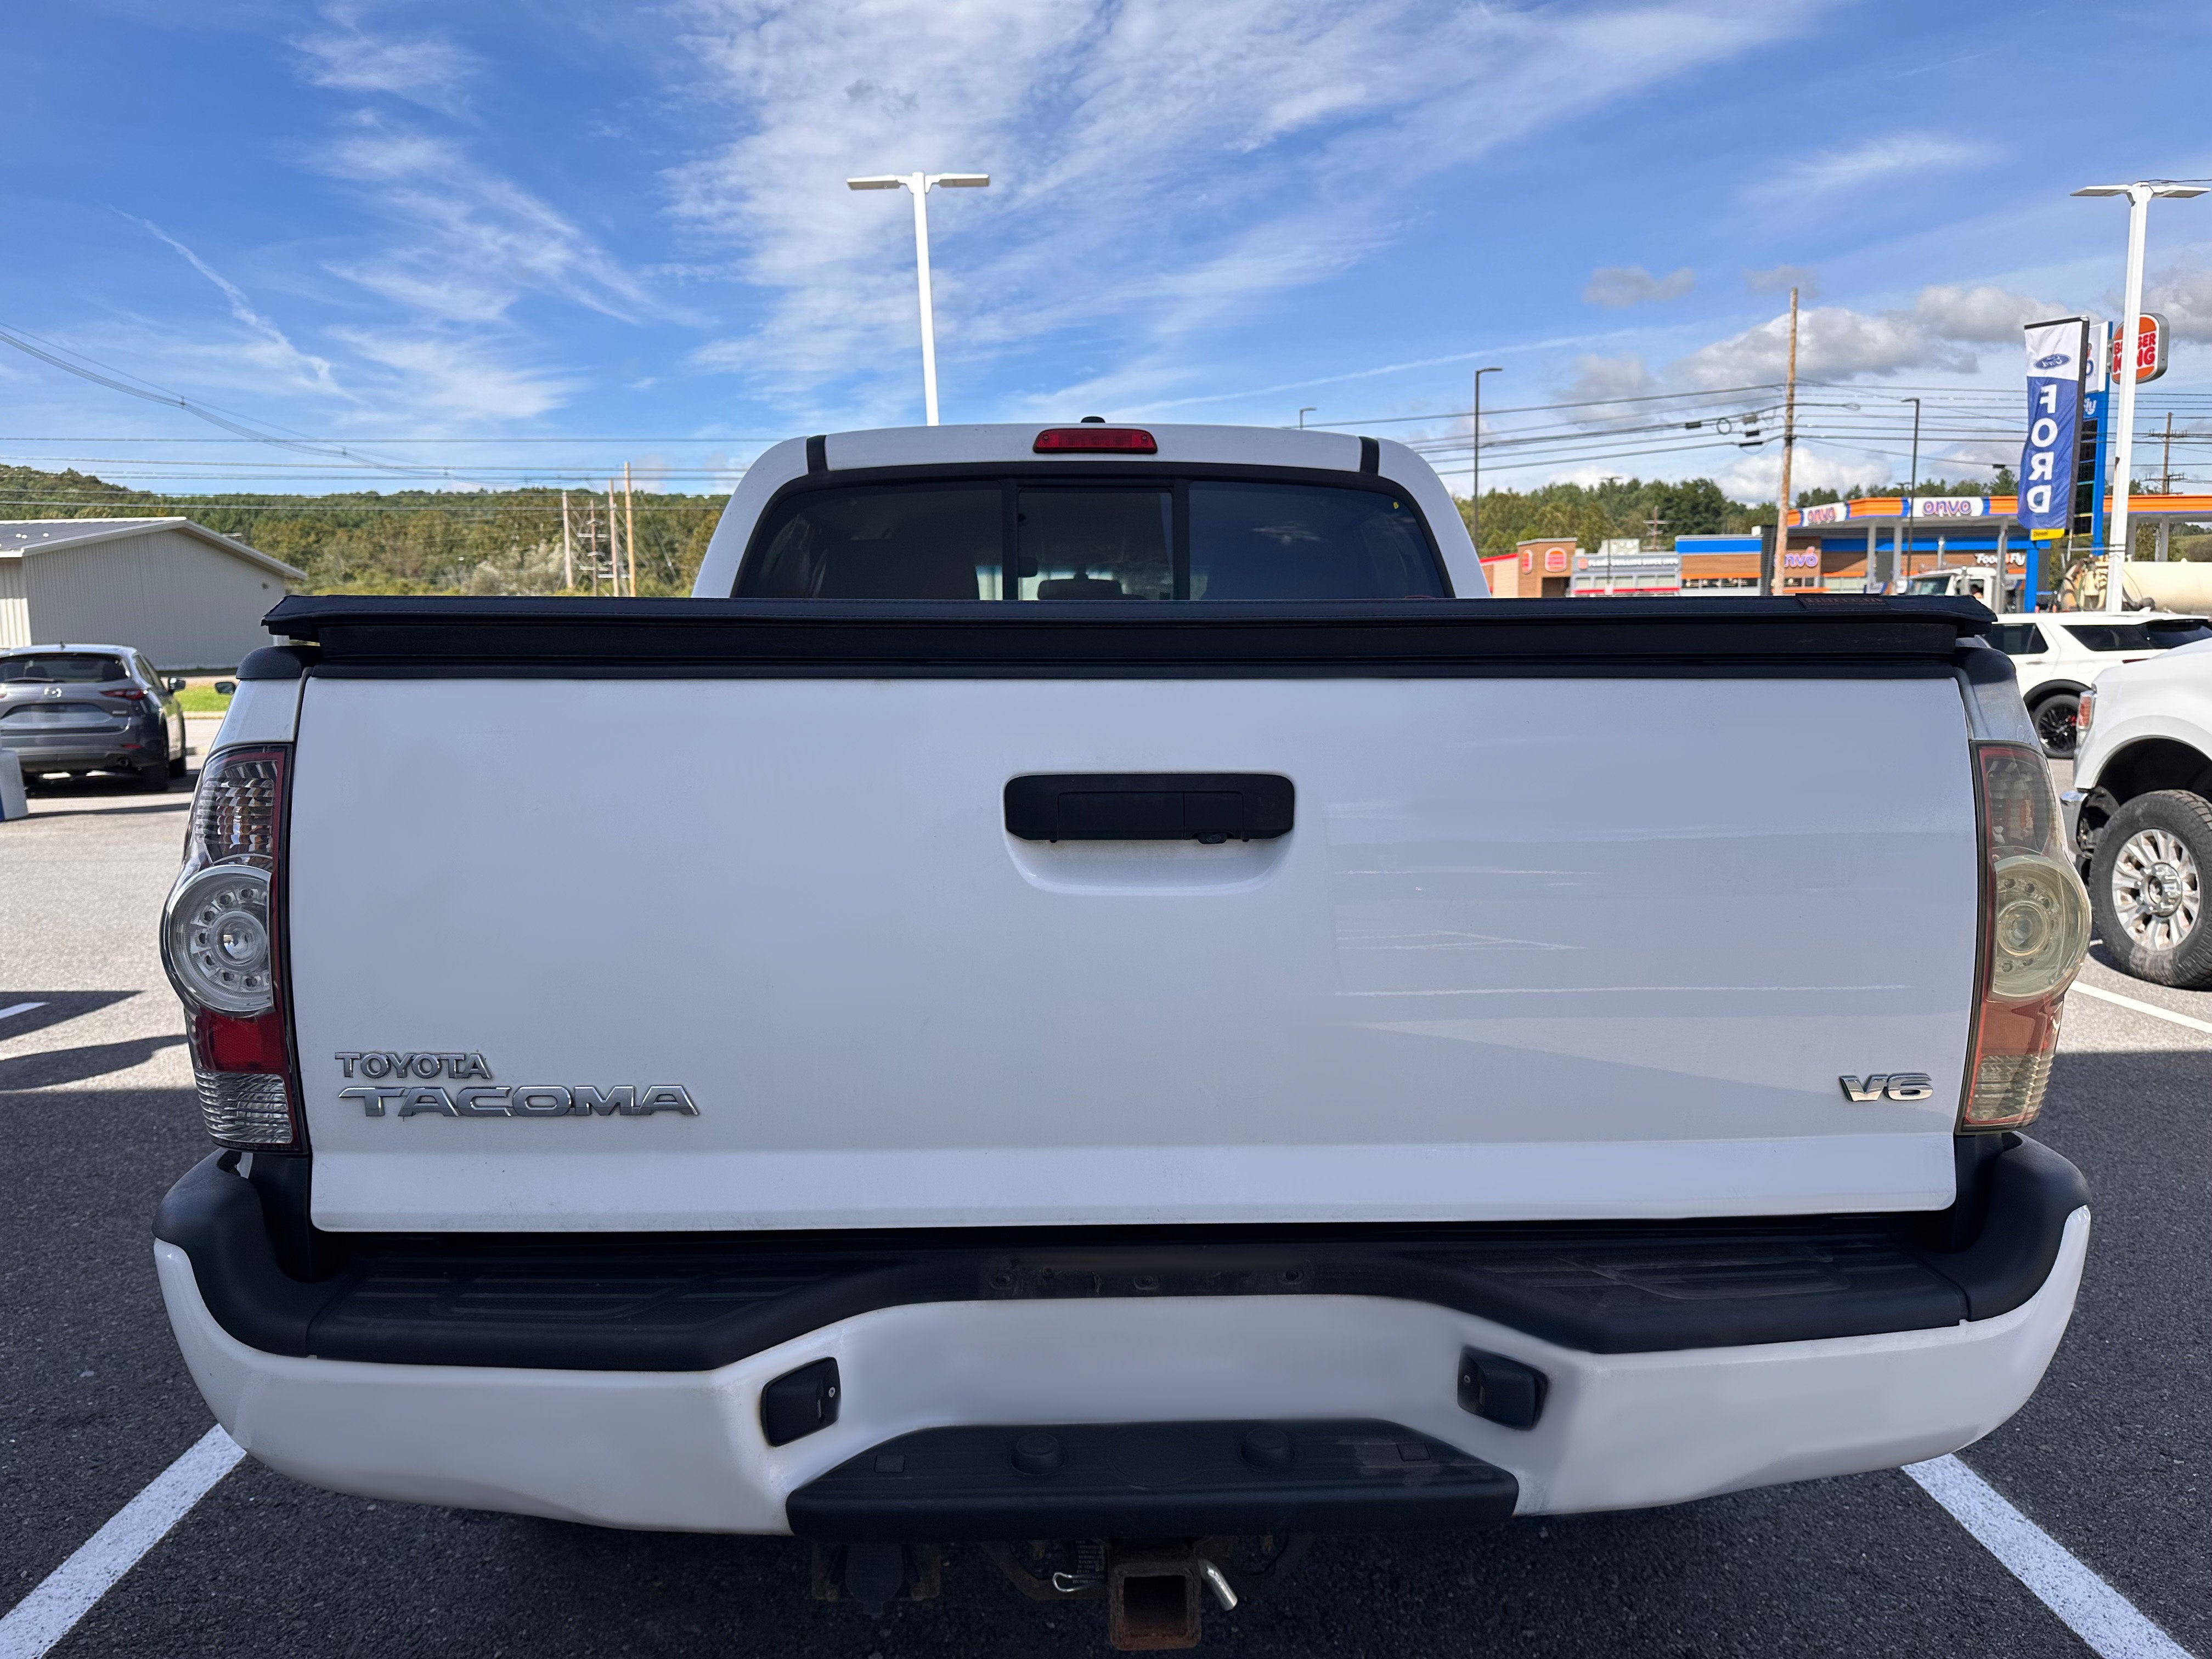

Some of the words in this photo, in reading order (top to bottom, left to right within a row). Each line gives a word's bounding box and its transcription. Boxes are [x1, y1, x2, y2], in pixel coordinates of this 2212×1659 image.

[1923, 500, 1971, 515] onvo
[1774, 553, 1818, 567] nvo
[335, 1052, 493, 1079] TOYOTA
[1839, 1073, 1933, 1101] V6
[338, 1086, 699, 1116] TACOMA
